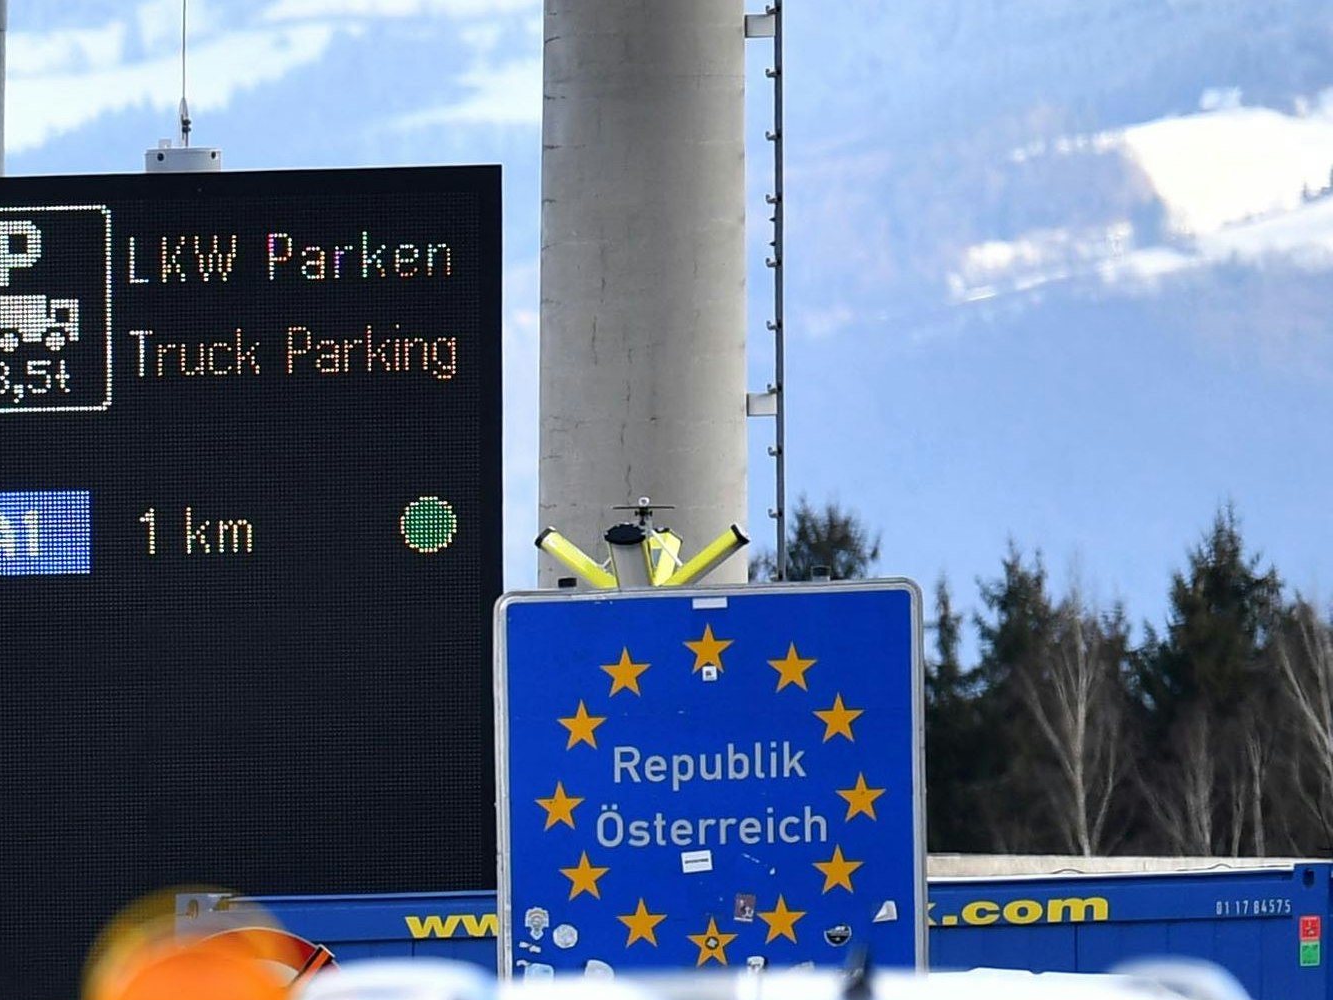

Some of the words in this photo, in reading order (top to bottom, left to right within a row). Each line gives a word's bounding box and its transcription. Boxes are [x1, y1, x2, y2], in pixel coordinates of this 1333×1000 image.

[128, 234, 237, 284] LKW
[267, 231, 453, 281] Parken
[128, 328, 261, 378] Truck
[285, 323, 459, 380] Parking
[139, 507, 156, 554] 1
[185, 506, 254, 554] km
[612, 741, 807, 792] Republik
[595, 804, 829, 849] Österreich
